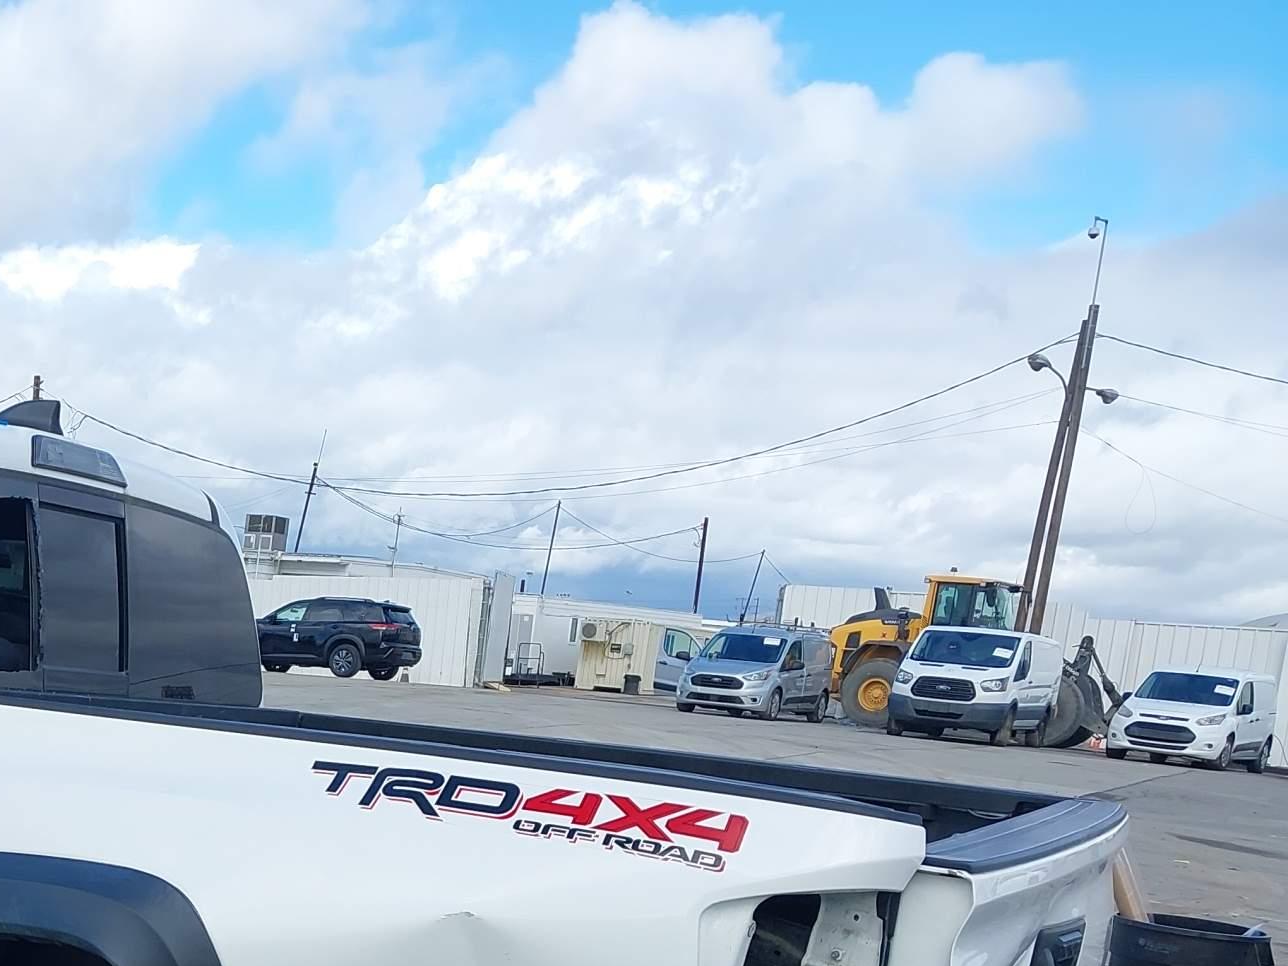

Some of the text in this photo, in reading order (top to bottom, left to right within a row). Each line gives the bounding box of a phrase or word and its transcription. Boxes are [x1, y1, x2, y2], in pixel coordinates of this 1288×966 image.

[312, 761, 523, 823] TRD
[512, 819, 726, 873] OFF ROAD
